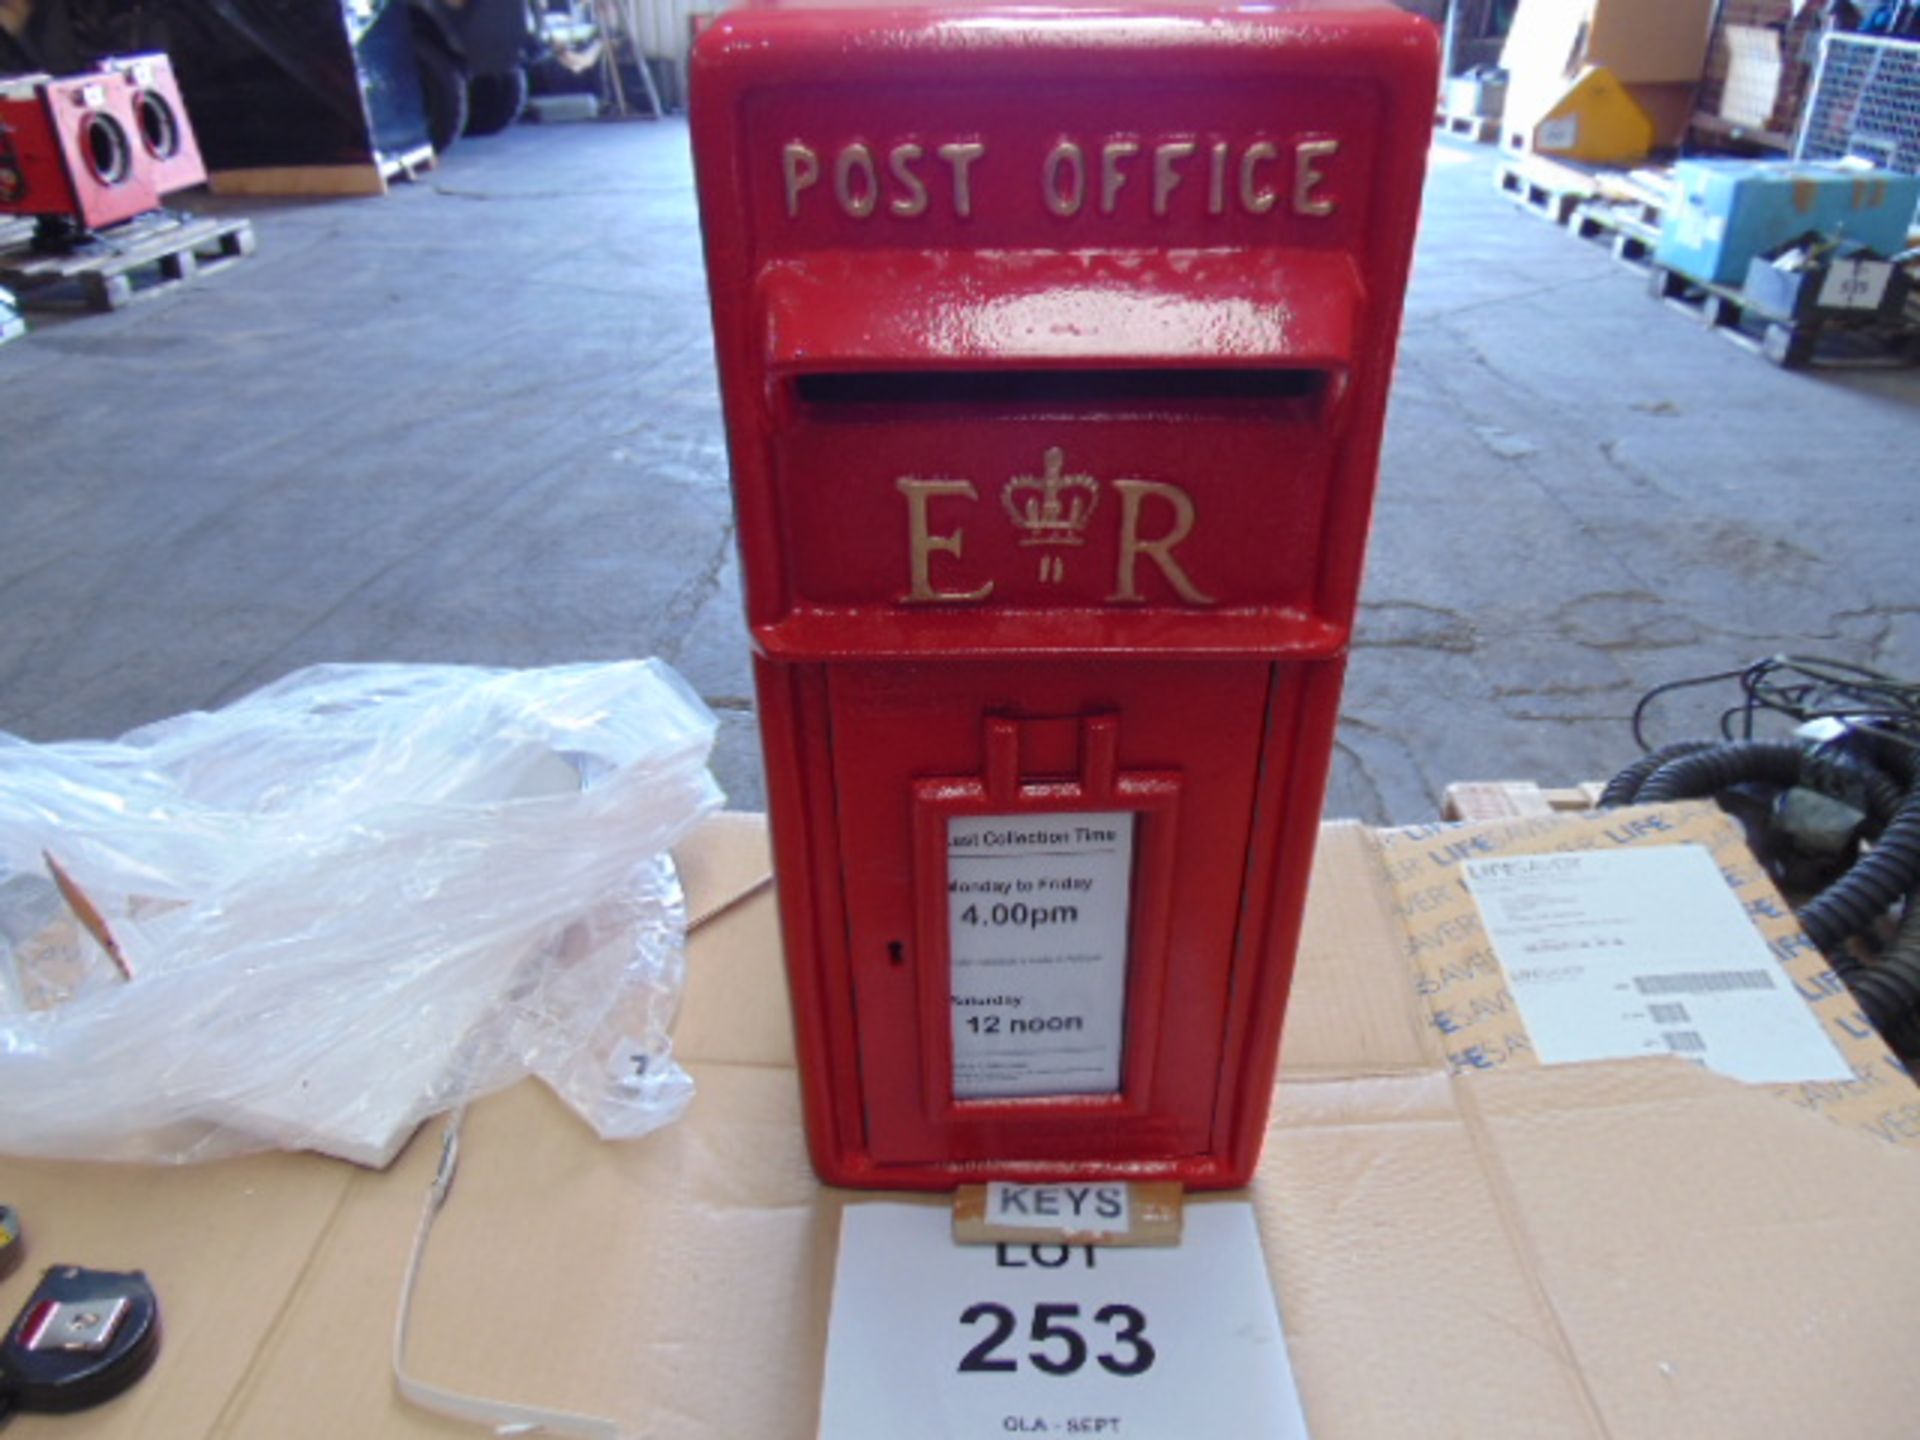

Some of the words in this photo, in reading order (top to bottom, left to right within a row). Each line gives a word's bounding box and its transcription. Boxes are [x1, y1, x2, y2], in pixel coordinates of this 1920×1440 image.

[782, 139, 984, 218] POST
[1044, 138, 1340, 217] OFFICE
[896, 476, 995, 604] E
[1112, 478, 1216, 604] R
[948, 831, 979, 848] ast
[983, 829, 1070, 847] Collection
[1074, 827, 1117, 843] Time
[1016, 879, 1032, 893] to
[1038, 877, 1093, 892] Friday
[961, 902, 1079, 930] 4.00pm
[966, 1016, 1001, 1034] 12
[1009, 1016, 1084, 1035] noon
[1000, 1186, 1122, 1218] KEYS
[957, 1301, 1156, 1376] 253
